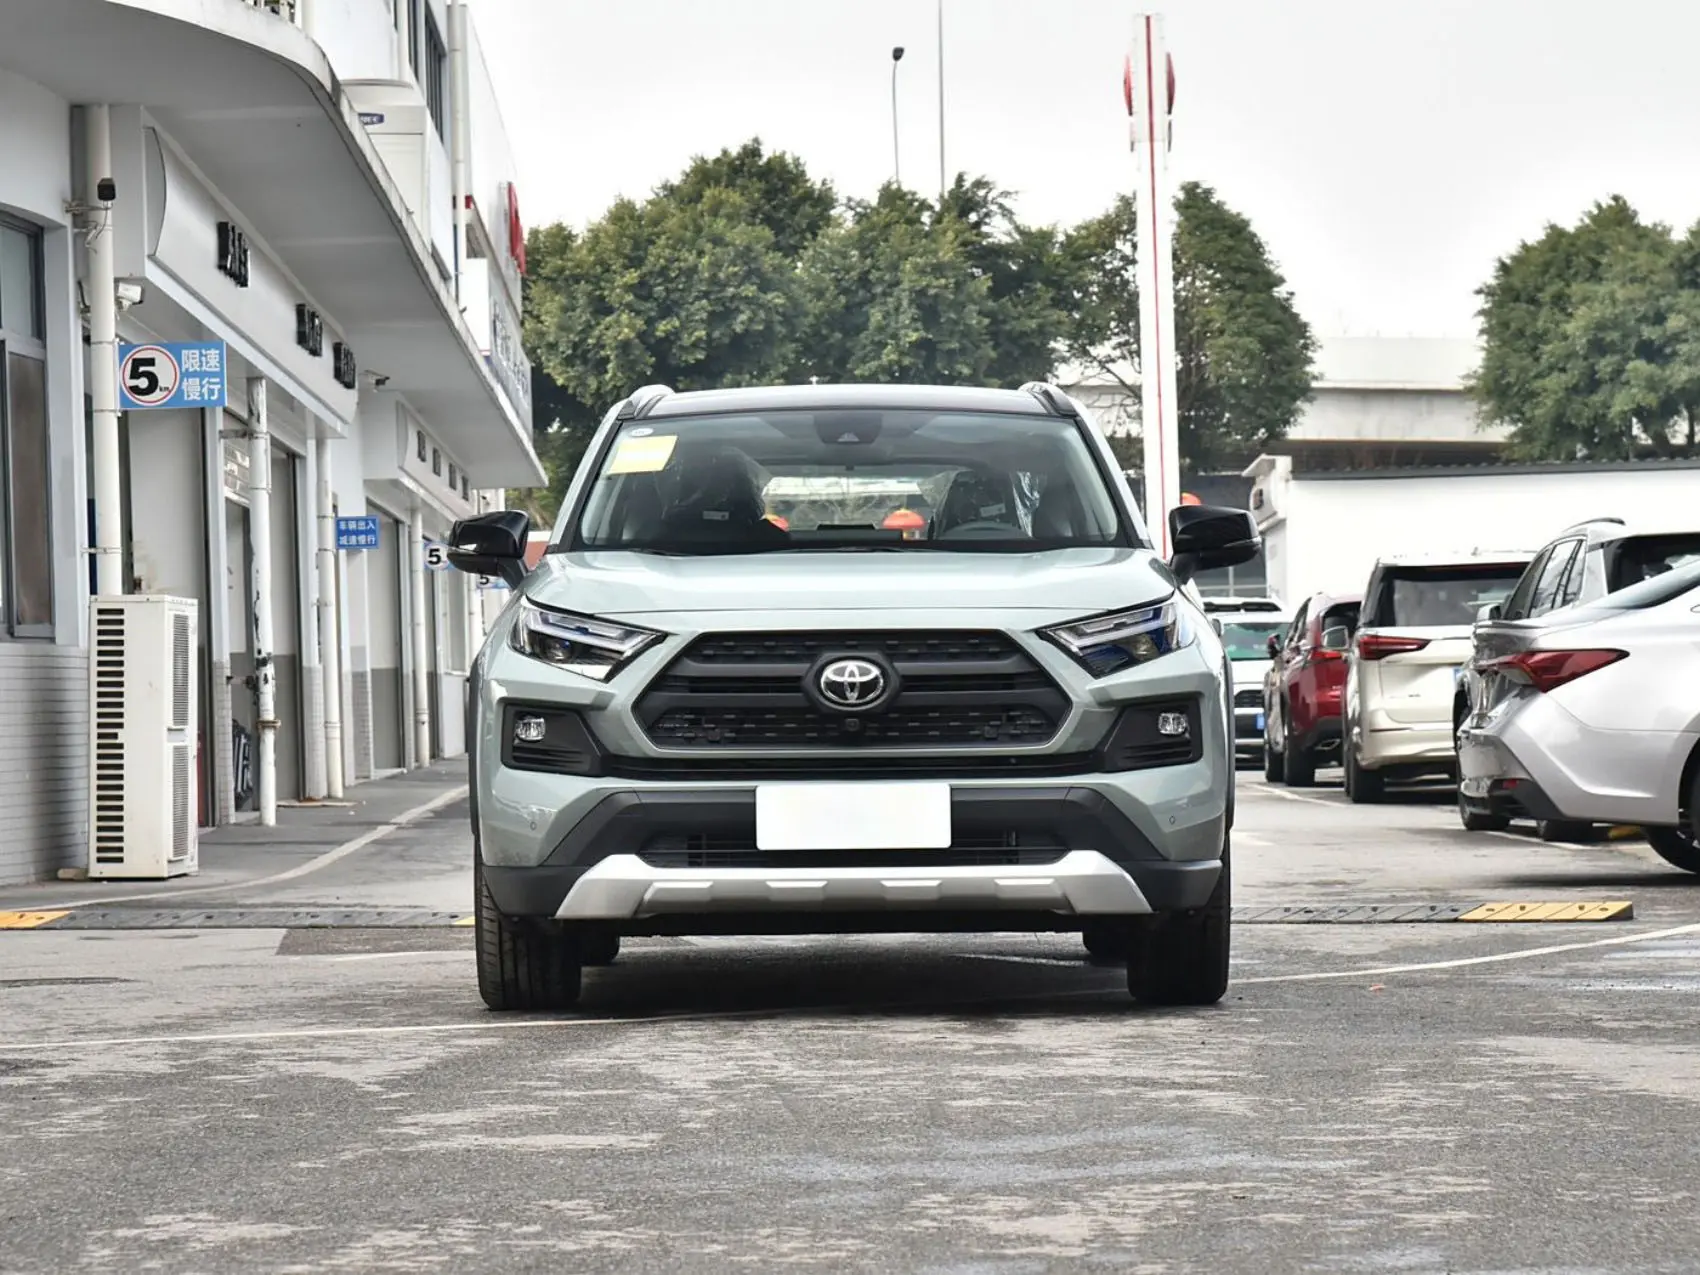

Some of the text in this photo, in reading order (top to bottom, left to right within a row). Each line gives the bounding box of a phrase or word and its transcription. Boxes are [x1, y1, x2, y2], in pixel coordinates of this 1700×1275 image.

[181, 349, 220, 372] 限速
[128, 357, 159, 396] 5
[181, 377, 221, 401] 慢行
[428, 548, 441, 565] 5
